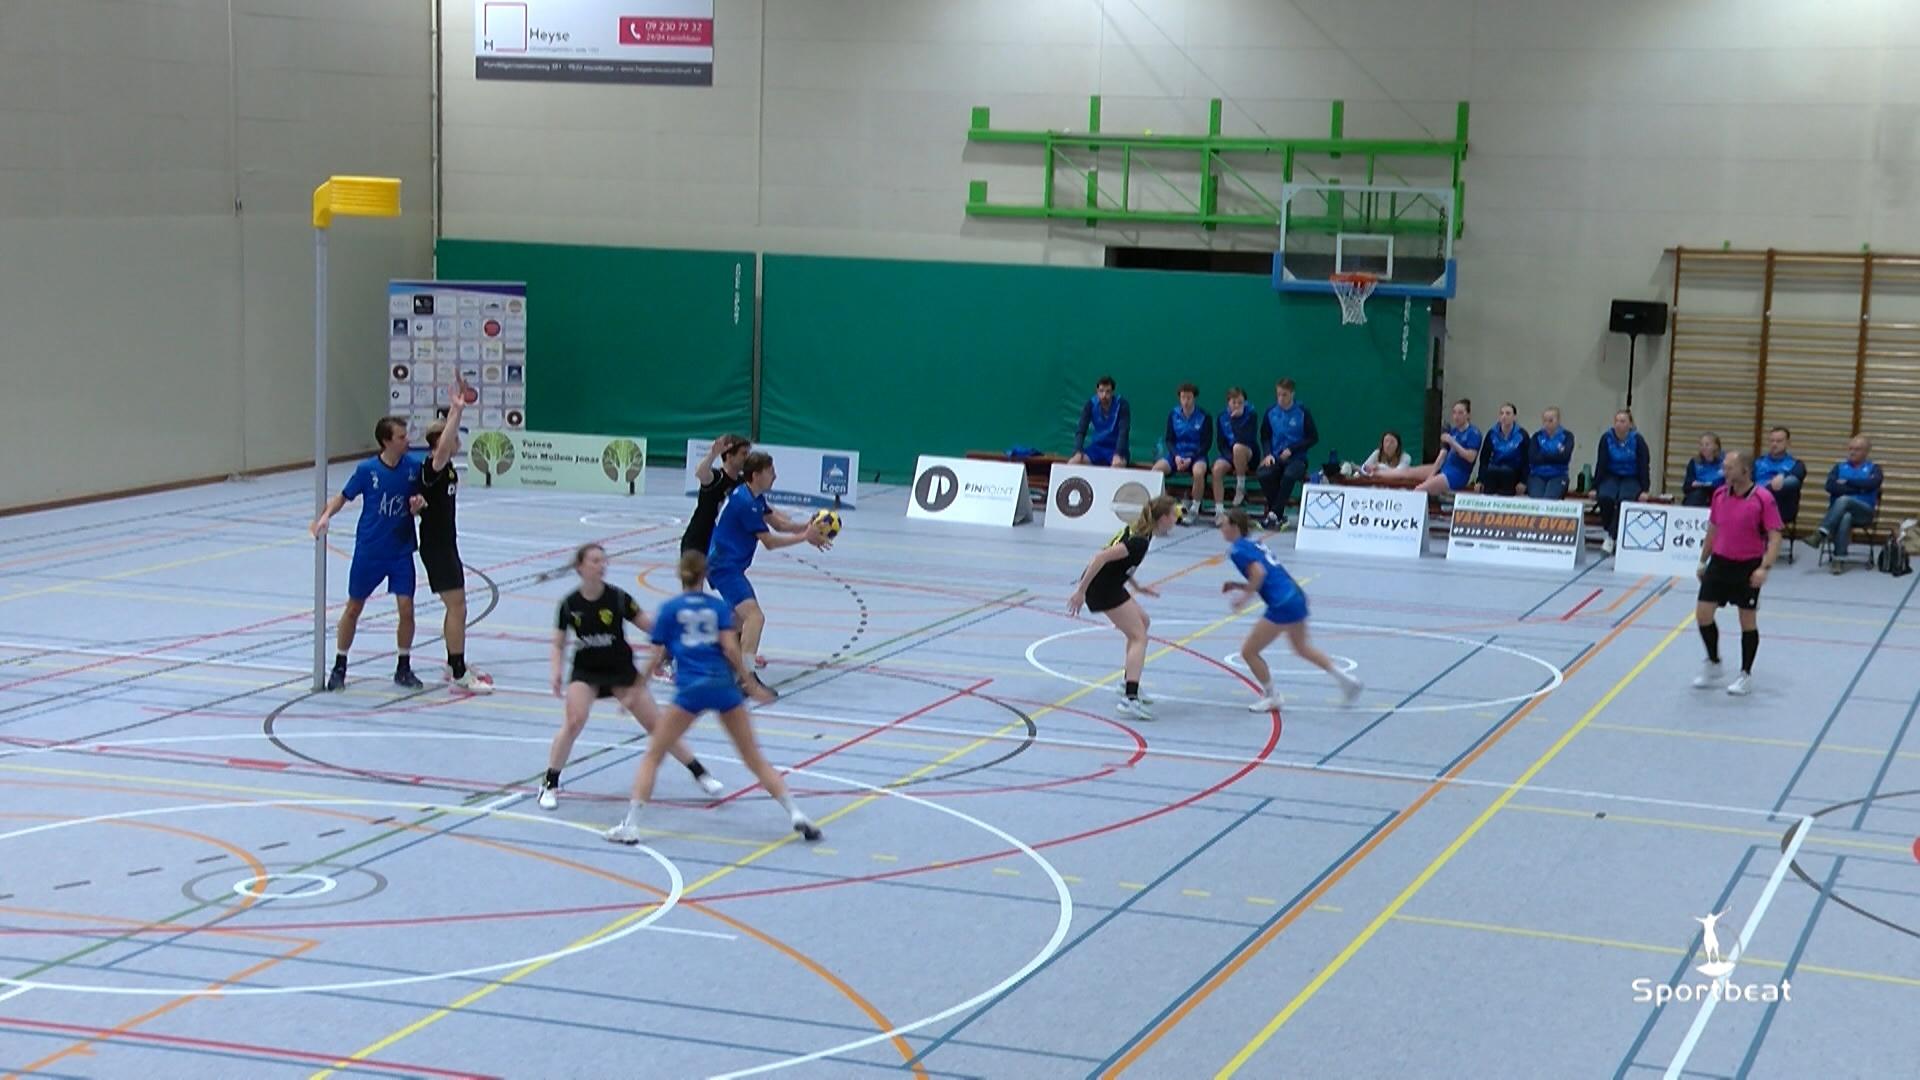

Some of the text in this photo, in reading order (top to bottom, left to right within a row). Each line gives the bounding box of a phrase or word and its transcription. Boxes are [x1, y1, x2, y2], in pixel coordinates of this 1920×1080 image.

[529, 27, 571, 43] Heyse
[483, 39, 494, 51] H
[521, 451, 538, 460] Van
[575, 455, 600, 465] Jonas
[822, 480, 847, 494] Koen
[1350, 497, 1403, 512] estelle
[1348, 513, 1419, 531] de ruyck
[1454, 511, 1577, 532] VAN DAMME BVBA
[1673, 533, 1695, 547] de
